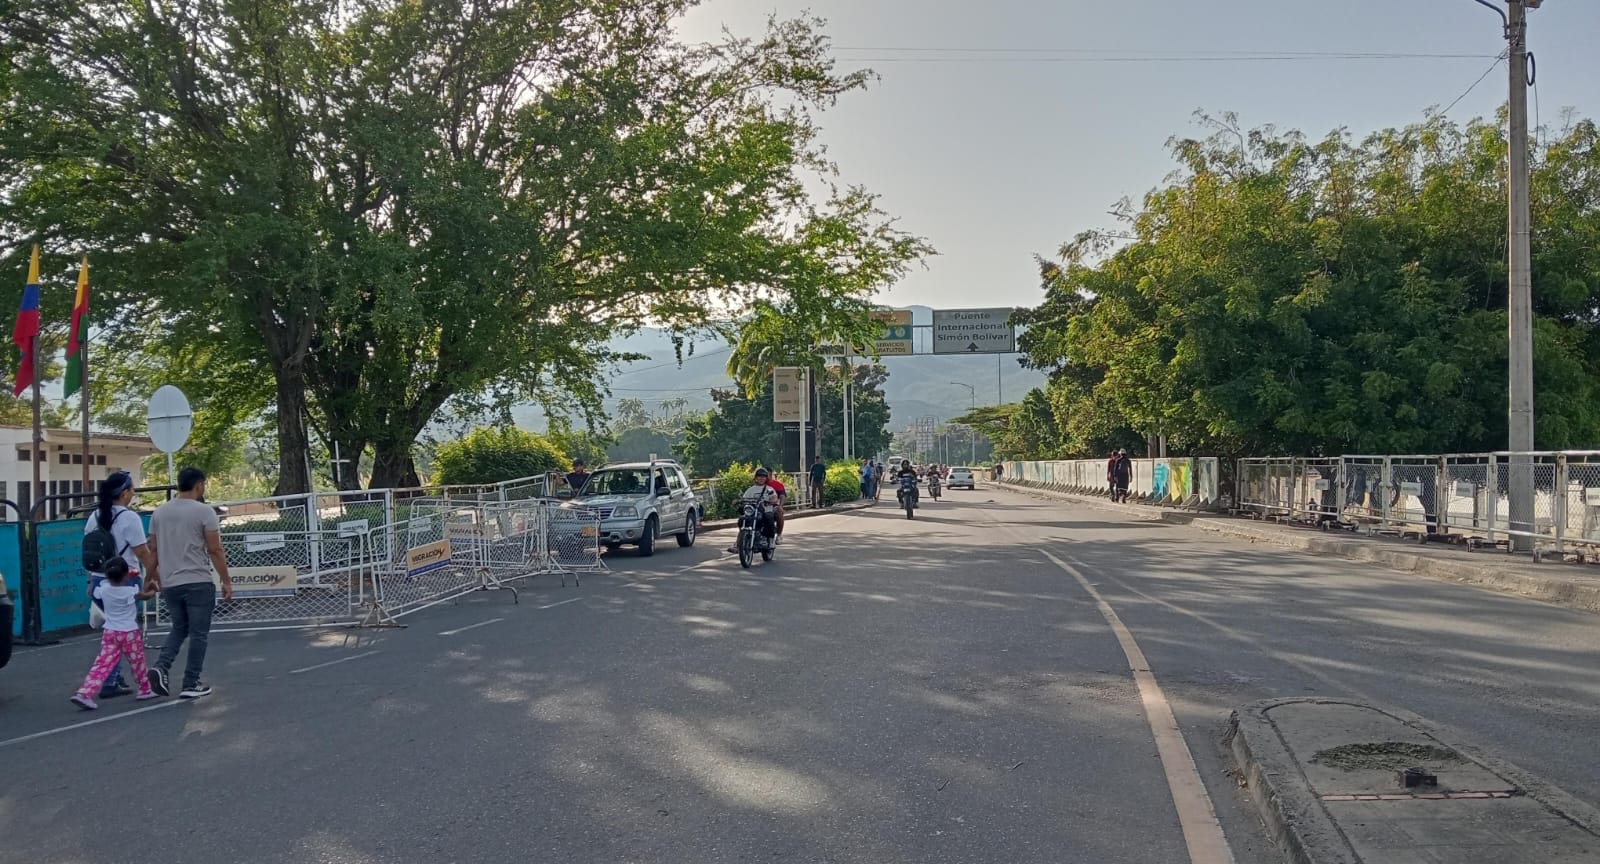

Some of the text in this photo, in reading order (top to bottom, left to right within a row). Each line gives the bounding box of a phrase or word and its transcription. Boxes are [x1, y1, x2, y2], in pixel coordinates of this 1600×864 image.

[953, 312, 991, 320] Puente
[938, 322, 1006, 331] Internacional
[937, 333, 970, 341] Simón
[220, 574, 279, 584] GRACIÓN
